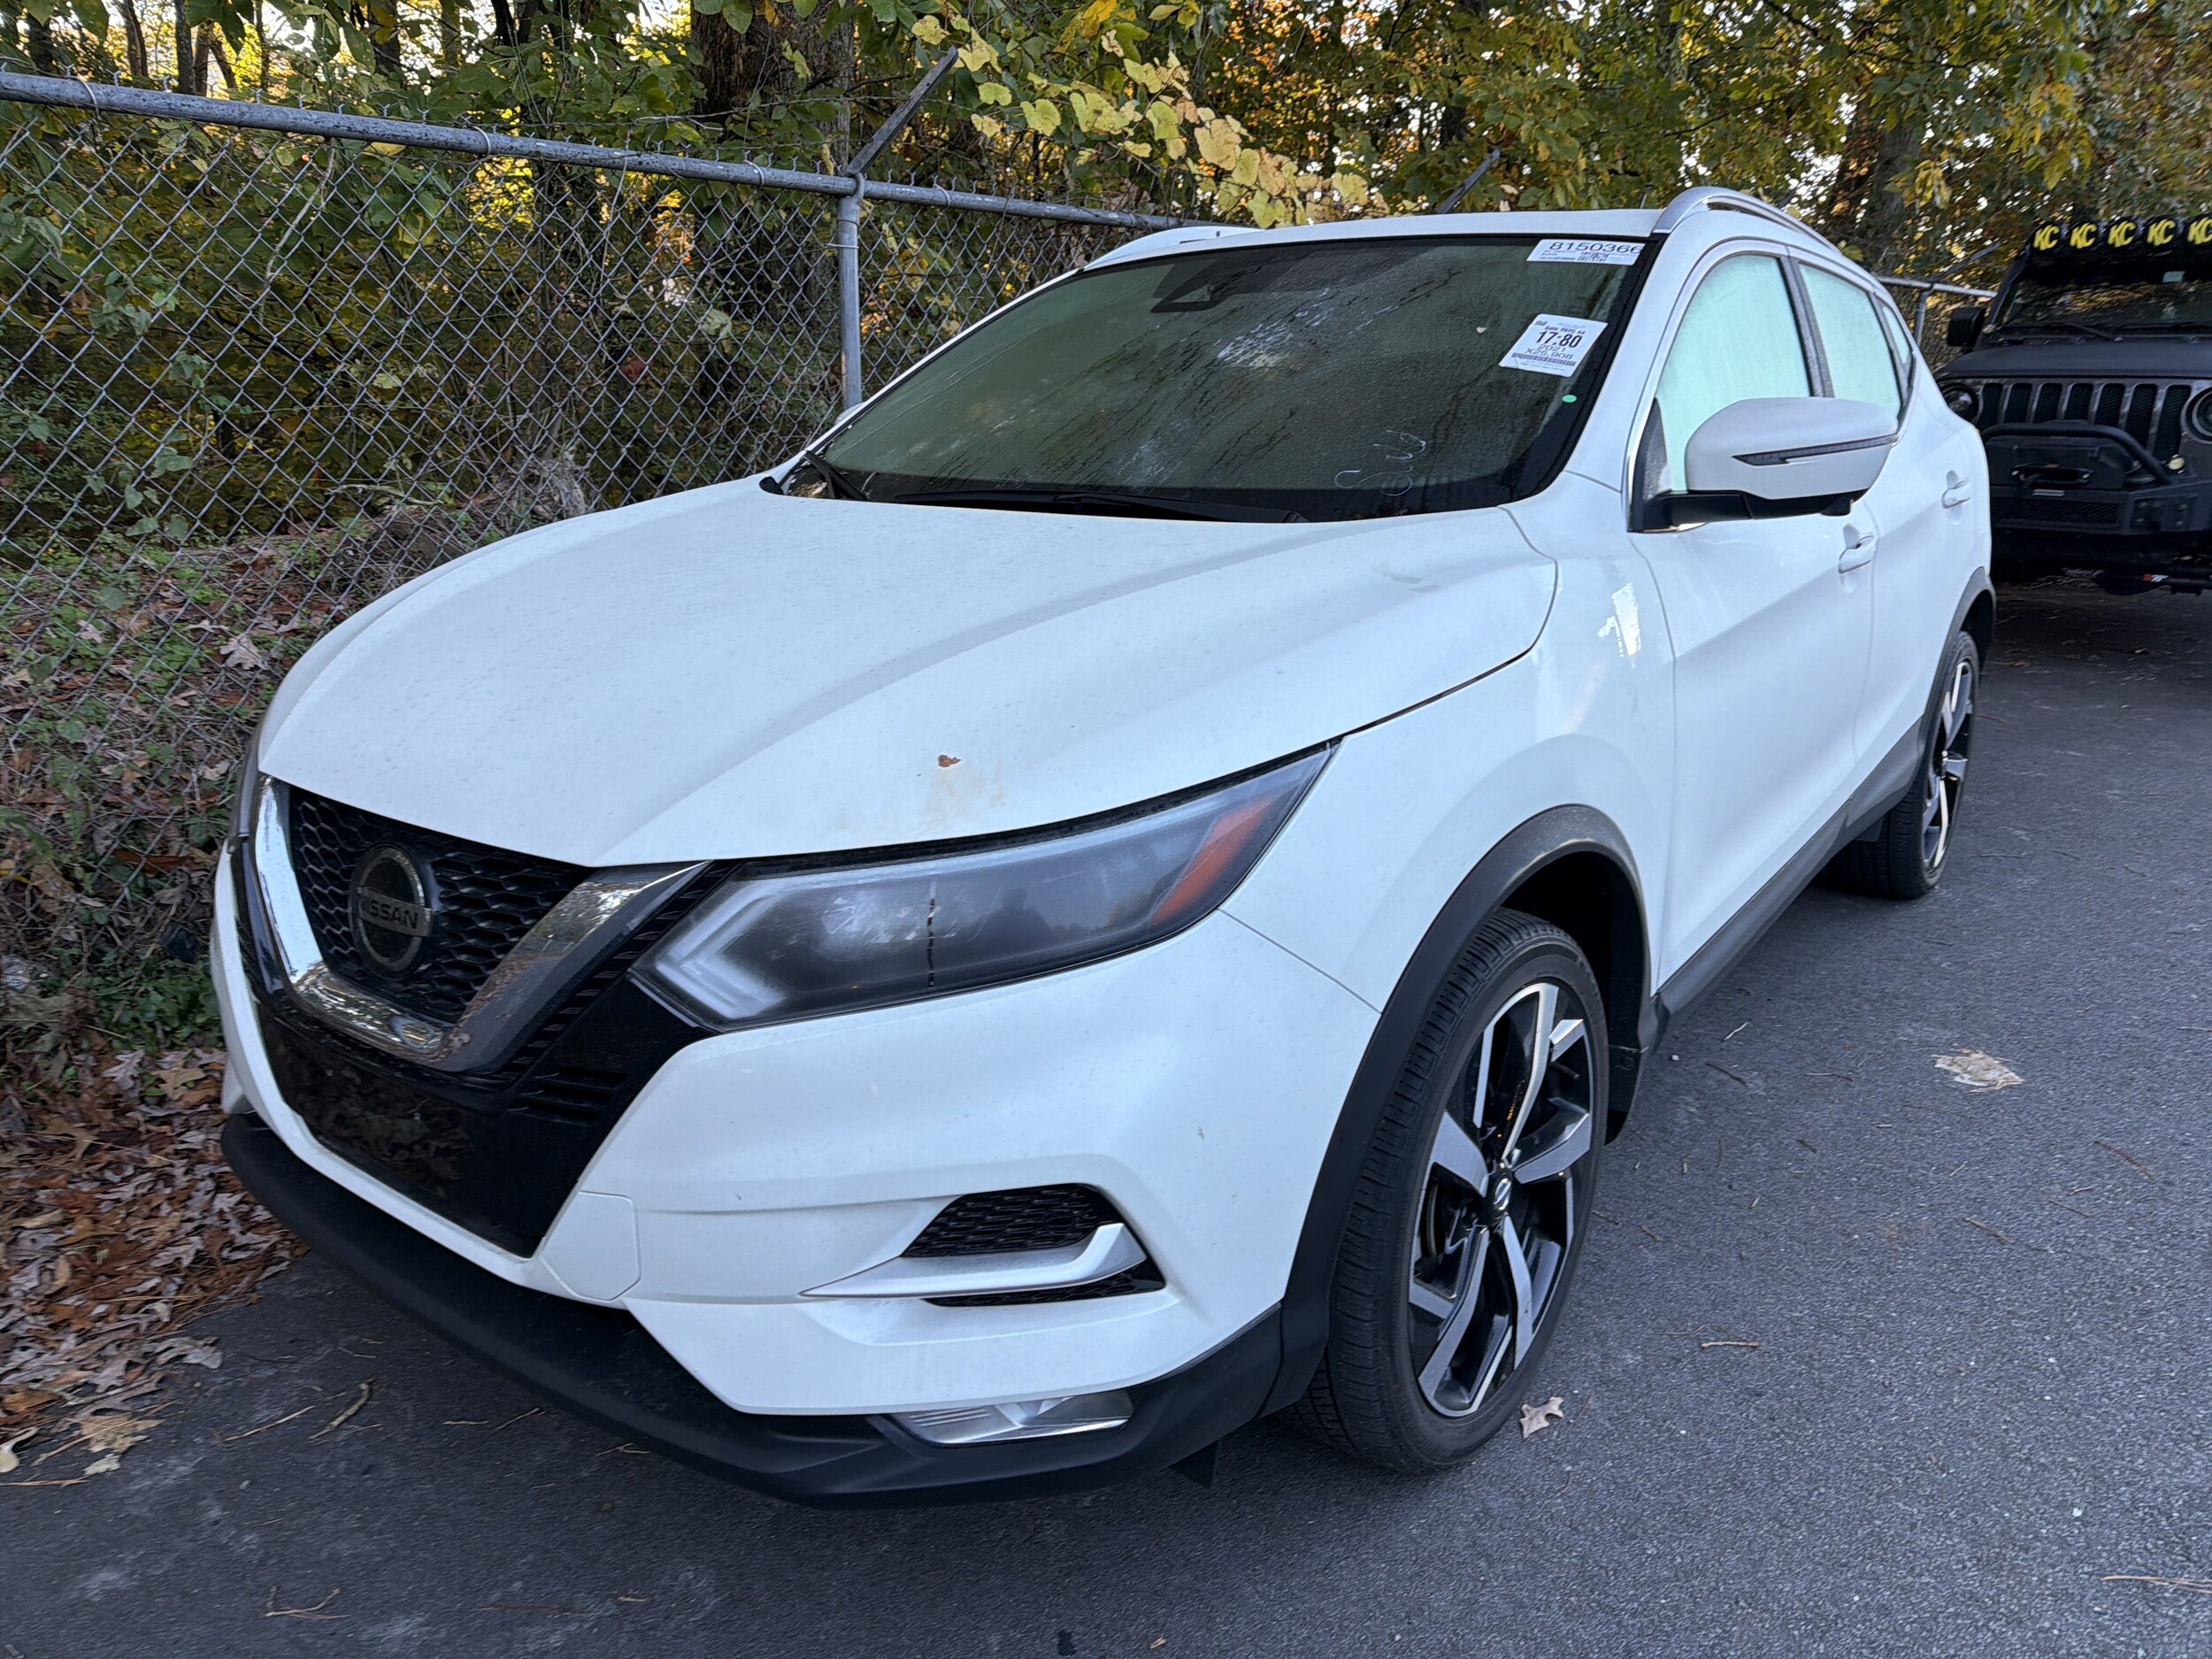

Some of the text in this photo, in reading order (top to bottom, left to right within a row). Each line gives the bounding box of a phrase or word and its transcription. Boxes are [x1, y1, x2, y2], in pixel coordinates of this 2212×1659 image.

[2033, 225, 2060, 250] KC
[2070, 223, 2097, 249] KC
[2108, 220, 2136, 248] KC
[2147, 219, 2176, 246] KC
[2187, 217, 2212, 244] KC
[1536, 330, 1582, 348] 17:80
[362, 897, 419, 929] NISSAN
